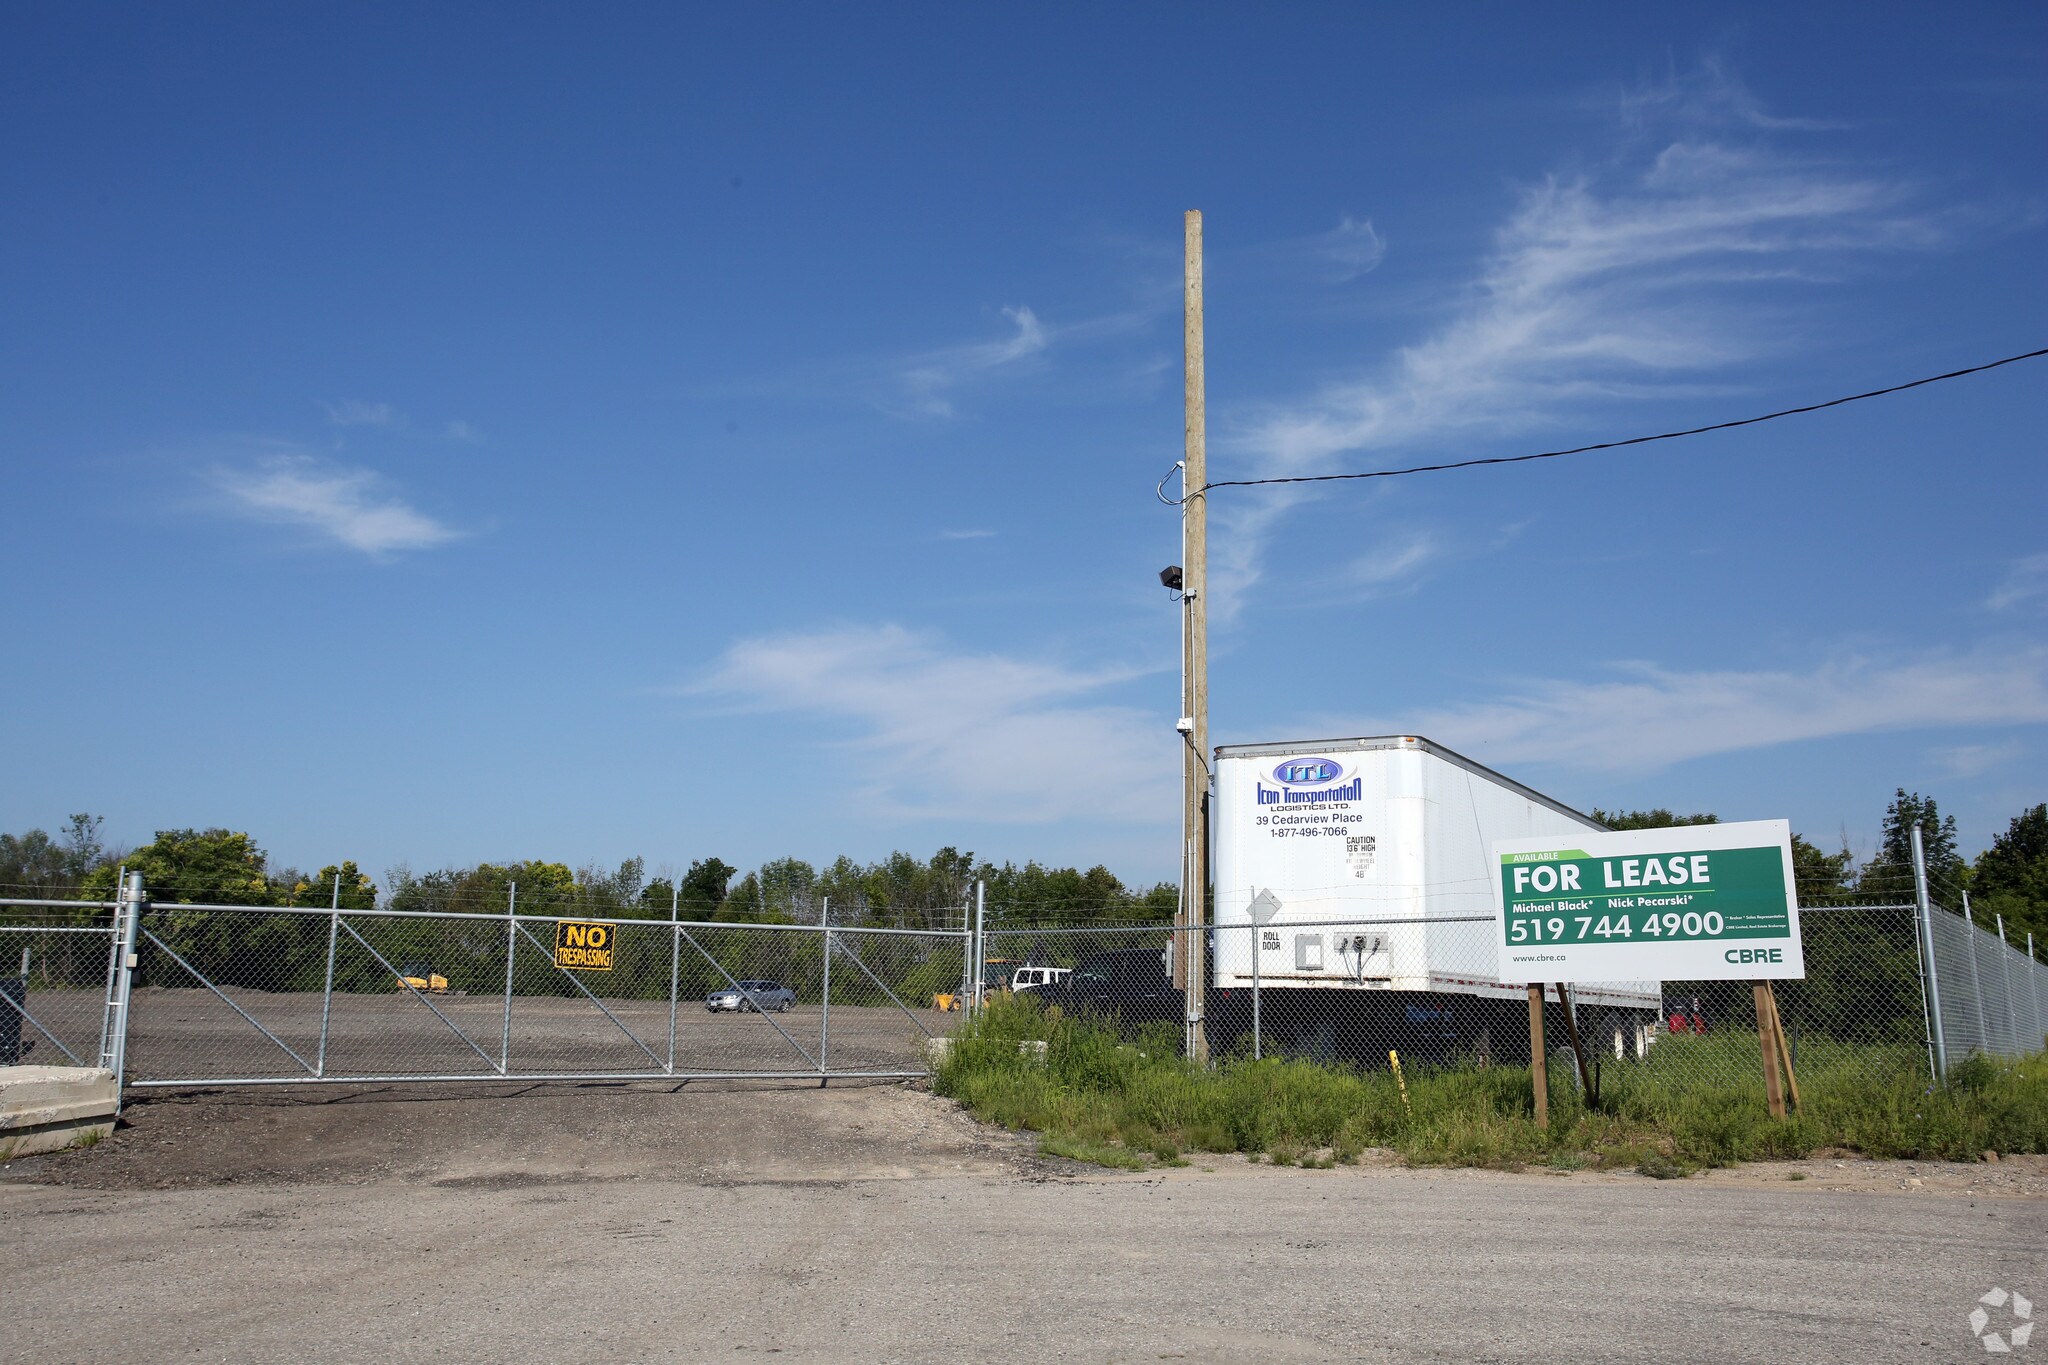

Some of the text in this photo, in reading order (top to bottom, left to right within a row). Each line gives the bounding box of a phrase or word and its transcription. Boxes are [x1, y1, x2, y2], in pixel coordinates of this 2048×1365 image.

[1285, 764, 1332, 782] ITL
[1257, 777, 1362, 805] Icon Transportation
[1270, 804, 1327, 812] LOGISTICS
[1256, 813, 1363, 825] 39 Cedarview Place
[1271, 827, 1348, 837] 1-877-496-7066
[1346, 836, 1376, 844] CAUTION
[1361, 844, 1376, 852] HIGH
[1513, 852, 1559, 862] AVAILABLE
[1513, 855, 1710, 894] FOR LEASE
[1512, 902, 1554, 913] Michael
[1608, 898, 1635, 908] Nick
[1511, 911, 1724, 942] 519 744 4900
[566, 925, 607, 948] NO
[1263, 931, 1280, 941] ROLL
[1262, 941, 1281, 950] DOOR
[559, 948, 611, 966] TRESPASSING
[1512, 954, 1566, 962] www.cbre.ca
[1724, 948, 1783, 964] CBRE
